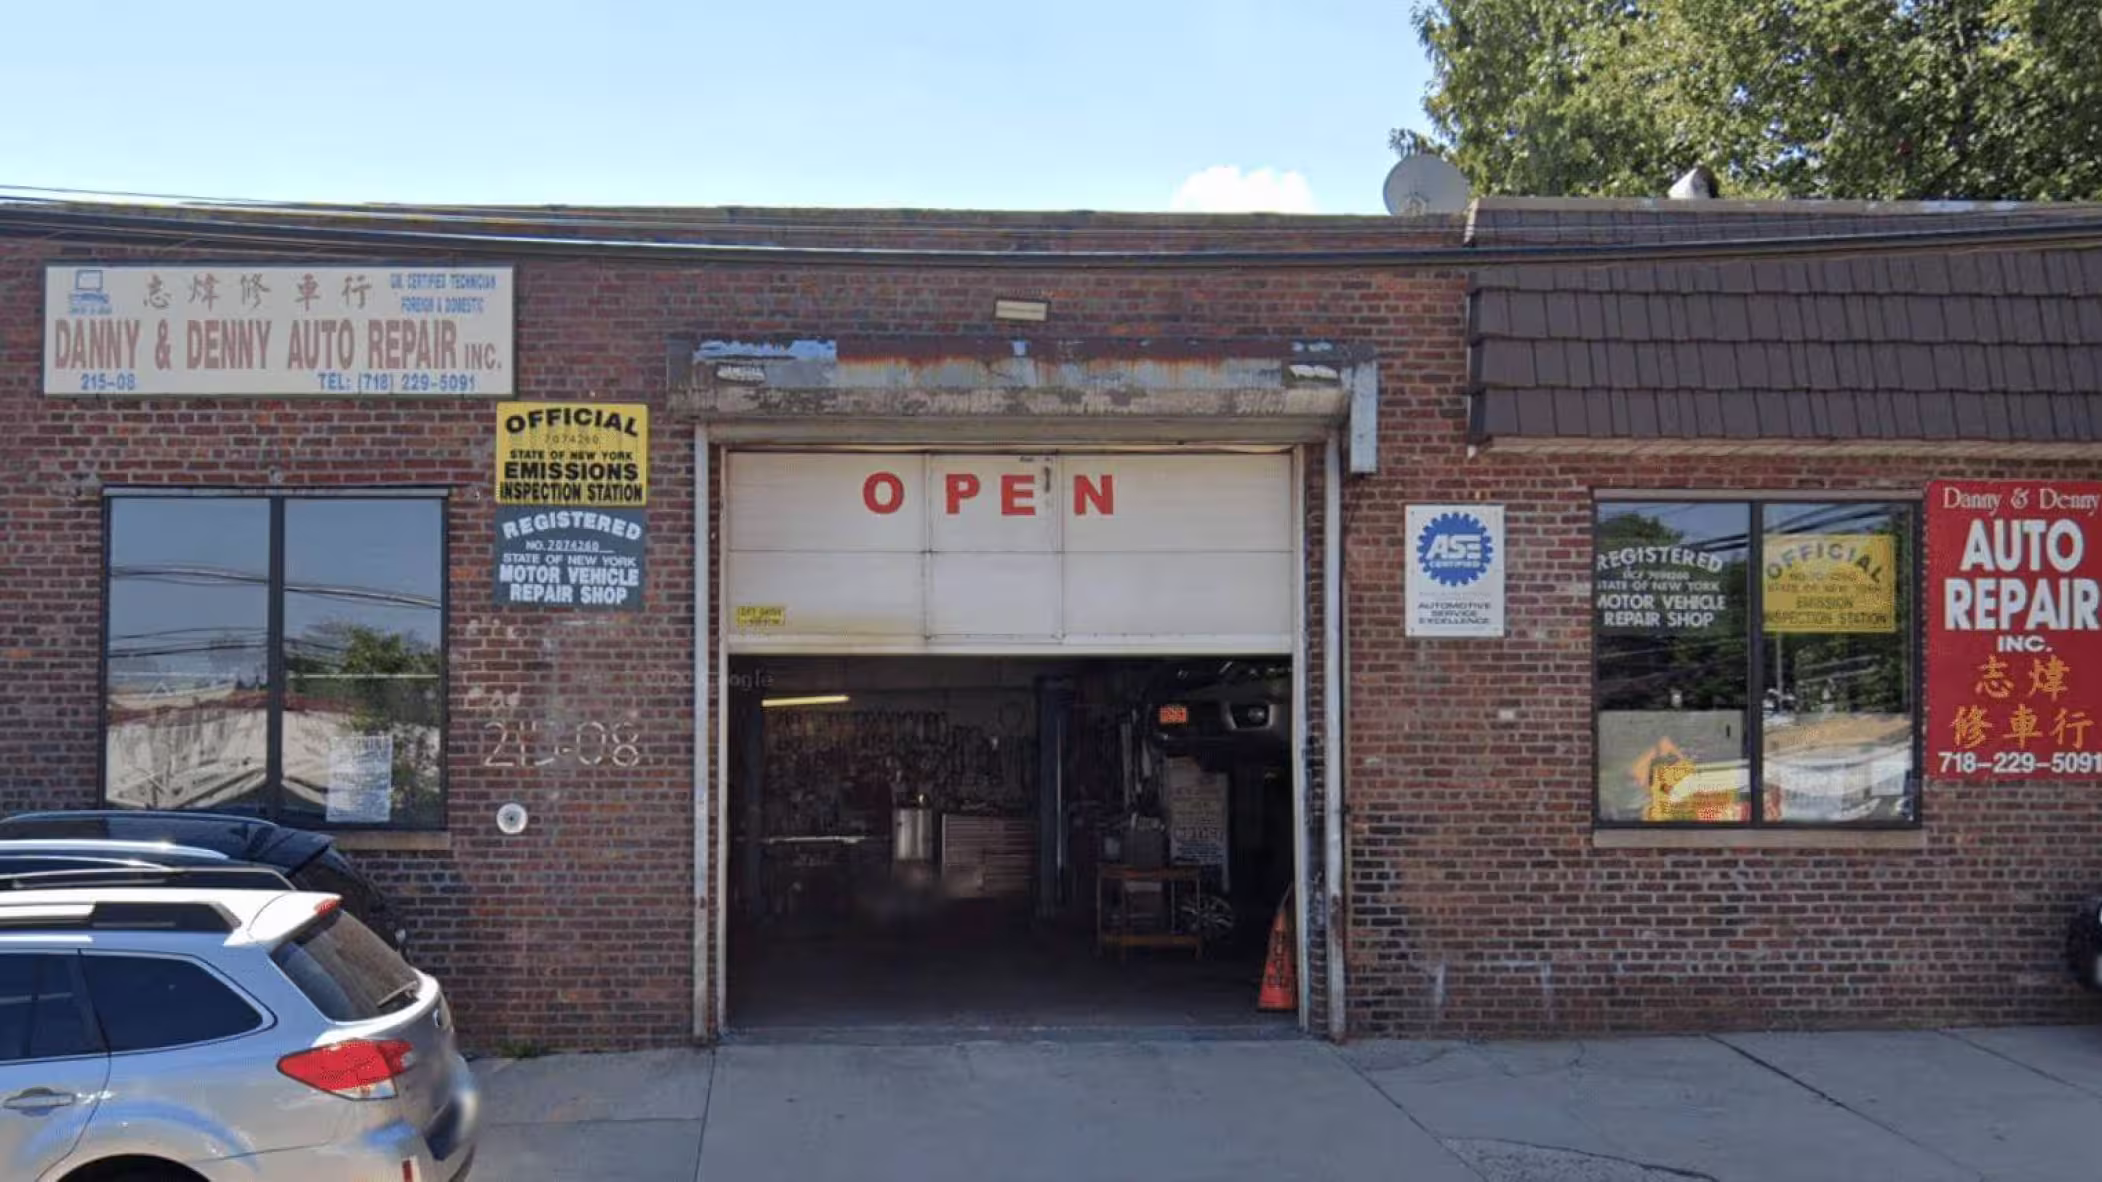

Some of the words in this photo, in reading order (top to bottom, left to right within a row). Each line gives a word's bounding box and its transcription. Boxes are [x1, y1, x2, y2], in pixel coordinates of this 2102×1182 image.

[54, 319, 140, 370] DANNY
[154, 319, 172, 370] &
[186, 319, 272, 370] DENNY
[287, 319, 355, 370] AUTO
[368, 319, 457, 370] REPAIR
[464, 343, 502, 370] INC.
[81, 373, 136, 391] 215-08
[318, 373, 351, 391] TEL:
[358, 373, 394, 394] (718)
[402, 374, 475, 391] 229-5091
[505, 408, 638, 437] OFFICIAL
[510, 449, 545, 460] STATE
[550, 451, 565, 460] OF
[570, 451, 596, 460] NEW
[602, 451, 633, 461] YORK
[505, 462, 638, 481] EMISSIONS
[500, 481, 582, 500] INSPECTION
[587, 483, 642, 501] STATION
[863, 471, 1114, 516] OPEN
[1942, 486, 2002, 516] Danny
[2011, 487, 2030, 509] &
[2039, 487, 2100, 517] Denny
[502, 511, 642, 540] REGISTERED
[1426, 534, 1481, 560] ASE
[1959, 518, 2084, 573] AUTO
[503, 553, 541, 564] STATE
[545, 554, 563, 565] OF
[568, 555, 597, 566] NEW
[602, 556, 637, 567] YORK
[1597, 546, 1723, 573] REGISTERED
[1766, 543, 1882, 584] OFFICIAL
[500, 563, 561, 584] MOTOR
[567, 566, 640, 586] VEHICLE
[510, 584, 573, 603] REPAIR
[580, 586, 628, 605] SHOP
[1631, 581, 1648, 592] OF
[1652, 581, 1682, 592] NEW
[1687, 582, 1720, 592] YORK
[1418, 601, 1491, 609] AUTOMOTIVE
[1660, 595, 1727, 610] VEHICLE
[1944, 577, 2101, 631] REPAIR
[1603, 611, 1661, 626] REPAIR
[1666, 611, 1715, 627] SHOP
[1998, 635, 2053, 652] INC.
[1948, 703, 2095, 750] 修車行
[1938, 751, 2102, 773] 718-229-5091
